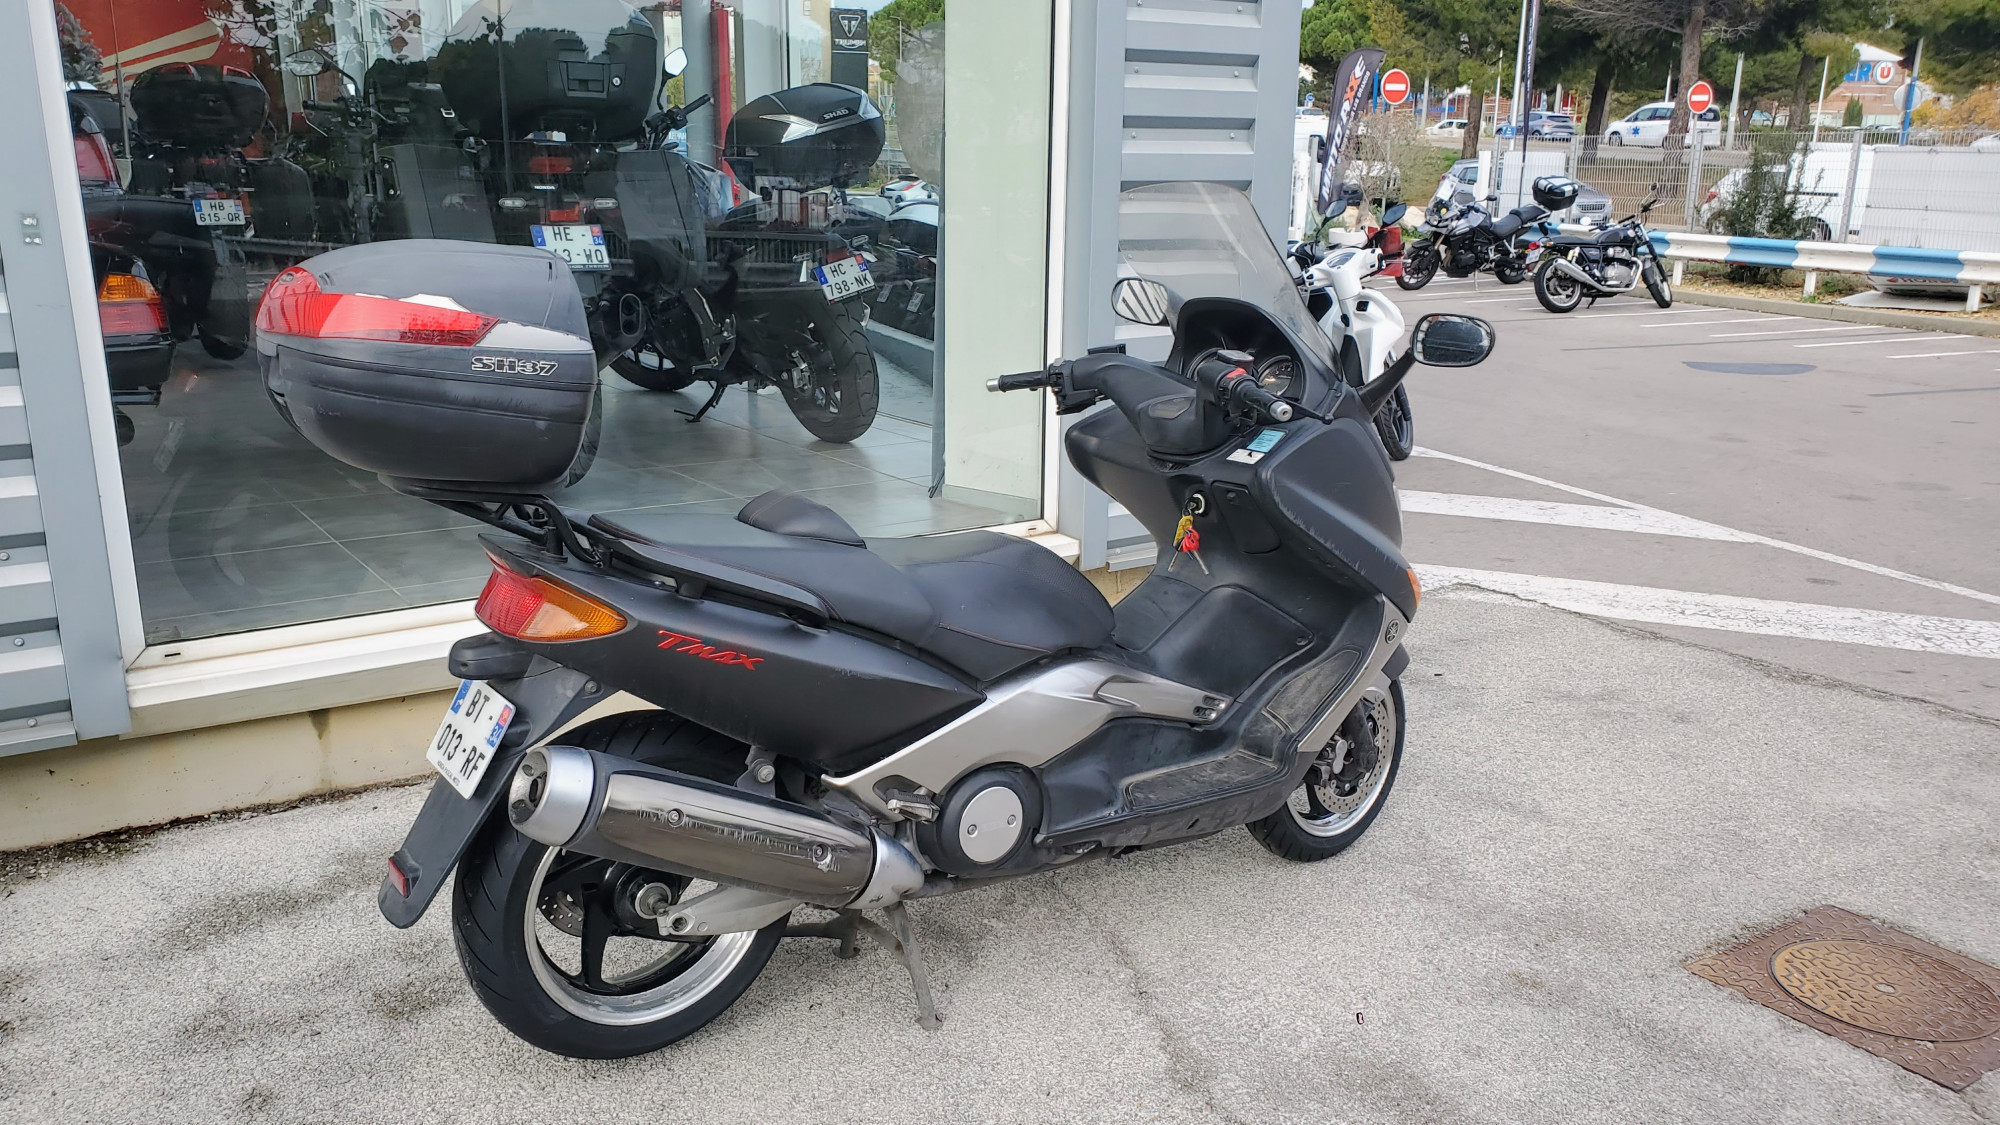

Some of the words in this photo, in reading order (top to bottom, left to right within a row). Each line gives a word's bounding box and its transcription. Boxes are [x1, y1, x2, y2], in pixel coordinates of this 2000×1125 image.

[823, 109, 849, 120] SHAD
[826, 273, 872, 297] 798-NK
[471, 356, 558, 376] SH37
[437, 723, 487, 780] 013-RF
